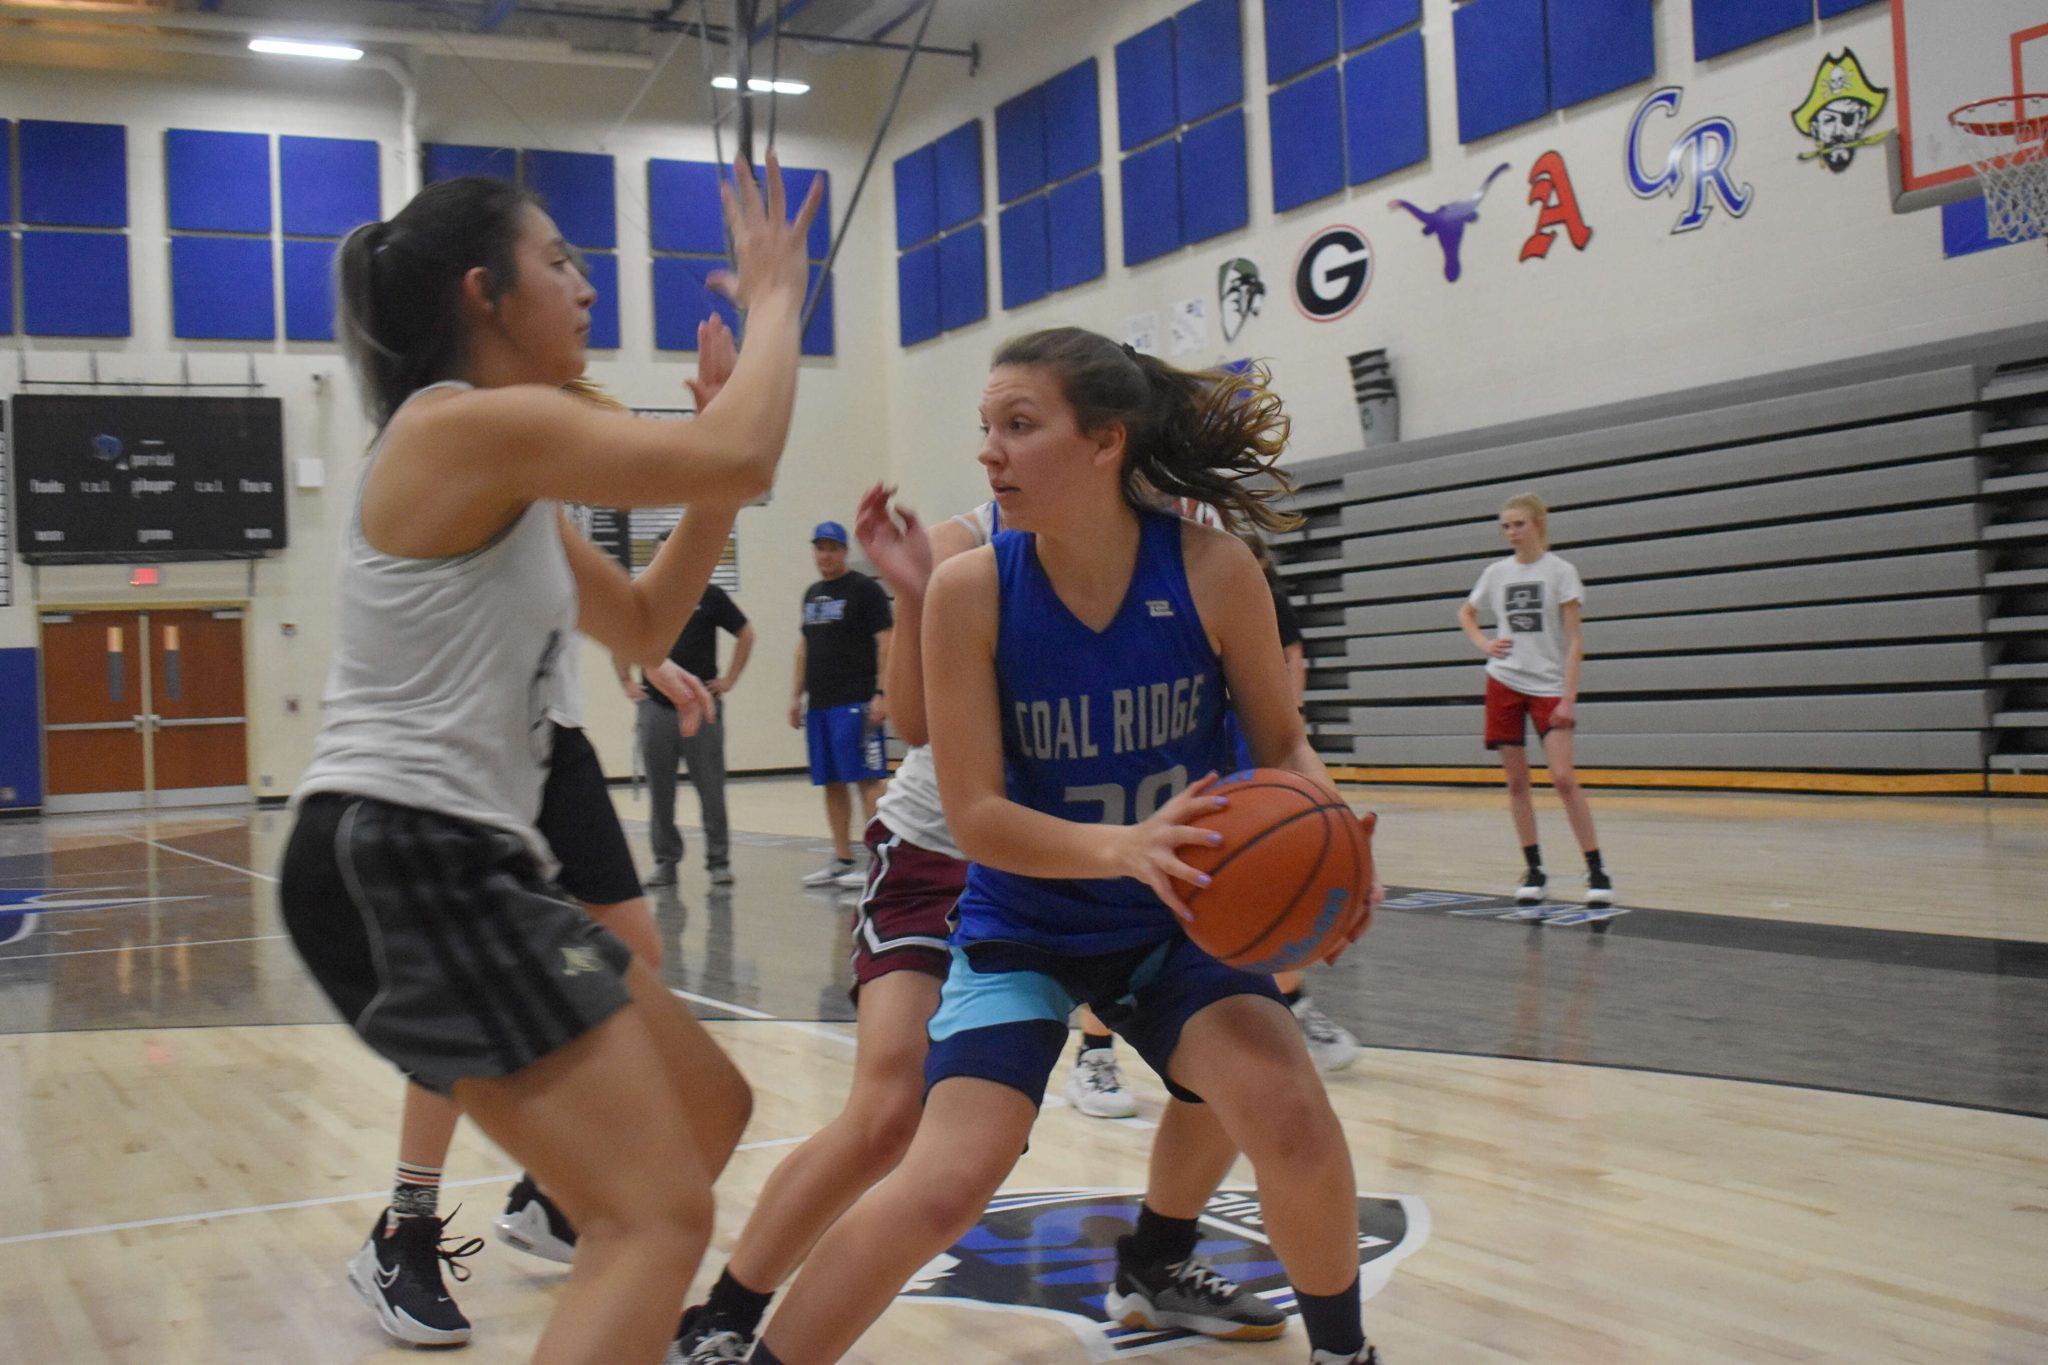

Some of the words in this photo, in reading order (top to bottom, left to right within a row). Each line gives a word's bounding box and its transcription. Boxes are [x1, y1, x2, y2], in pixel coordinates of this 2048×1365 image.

[1519, 149, 1593, 263] A
[1296, 230, 1369, 316] G
[1015, 695, 1099, 761] COAL
[1112, 674, 1205, 754] RIDGE
